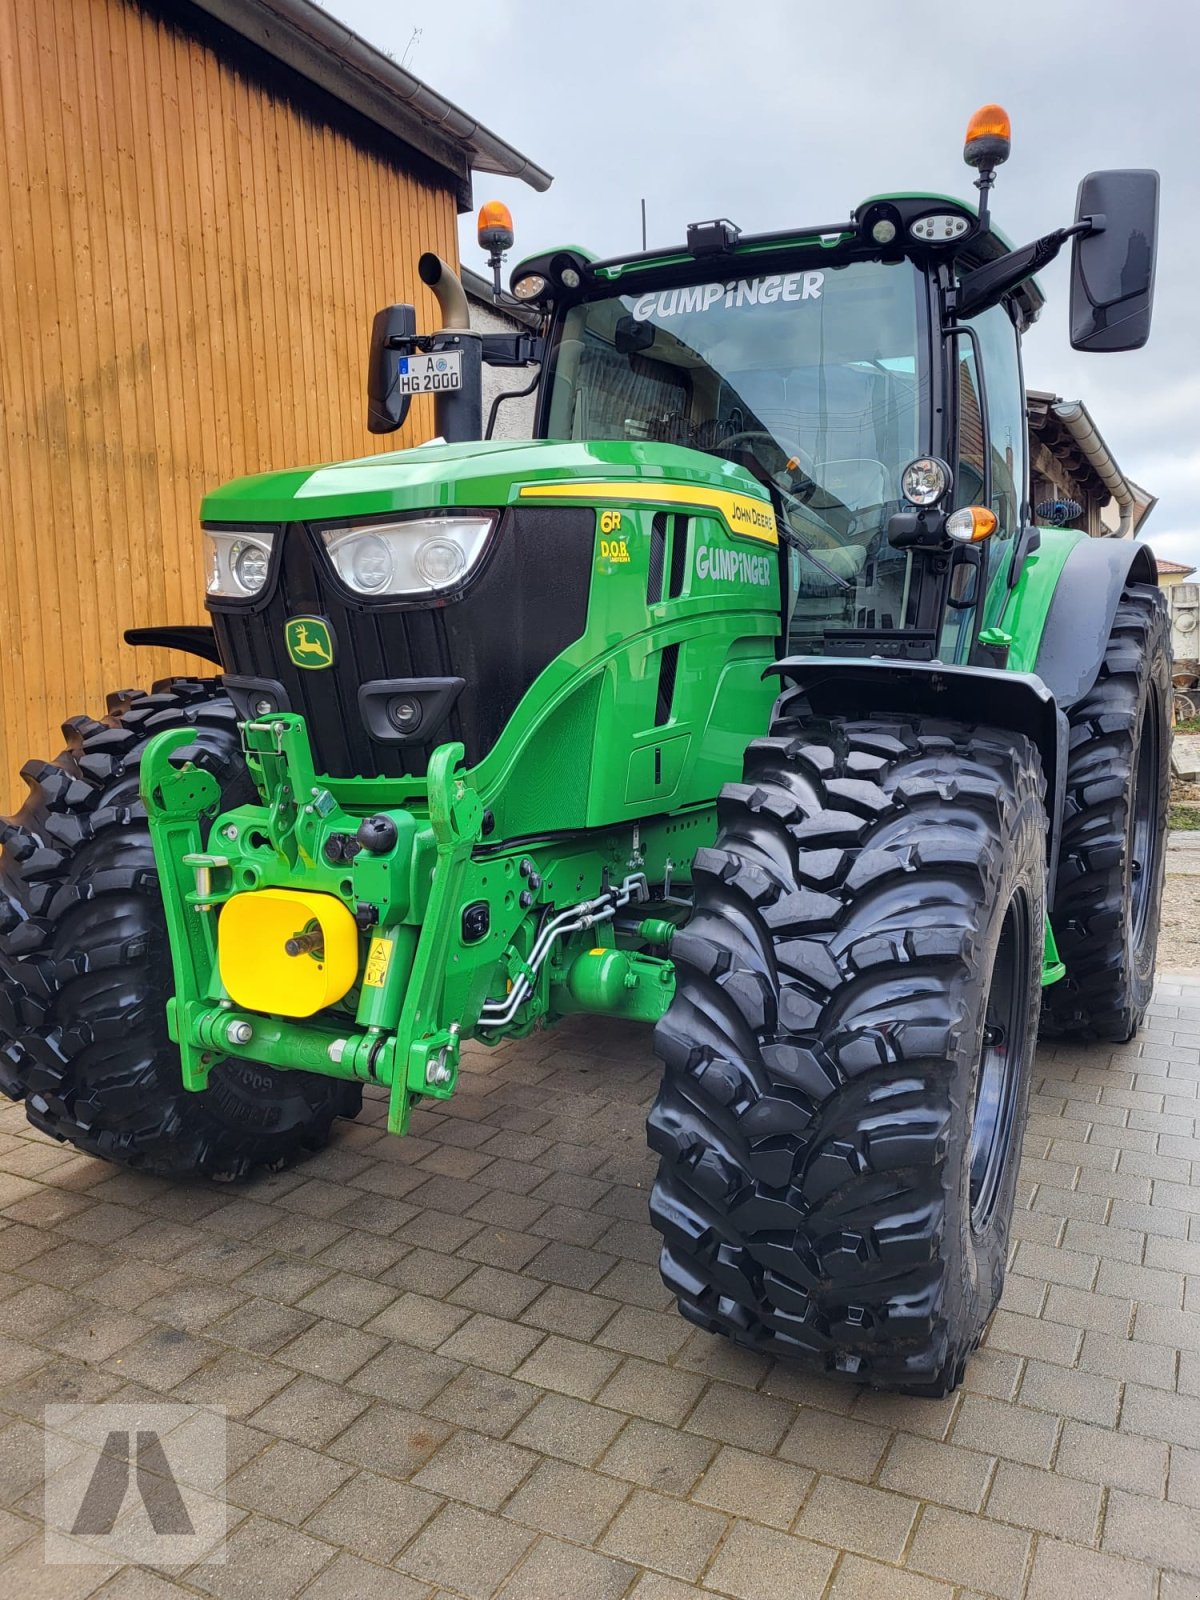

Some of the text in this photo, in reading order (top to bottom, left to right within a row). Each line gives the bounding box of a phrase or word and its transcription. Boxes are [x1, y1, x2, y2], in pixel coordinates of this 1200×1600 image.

[426, 357, 434, 372] A
[401, 372, 459, 393] HG 2000
[600, 510, 622, 535] 6R
[732, 502, 773, 530] JOHN DEERE
